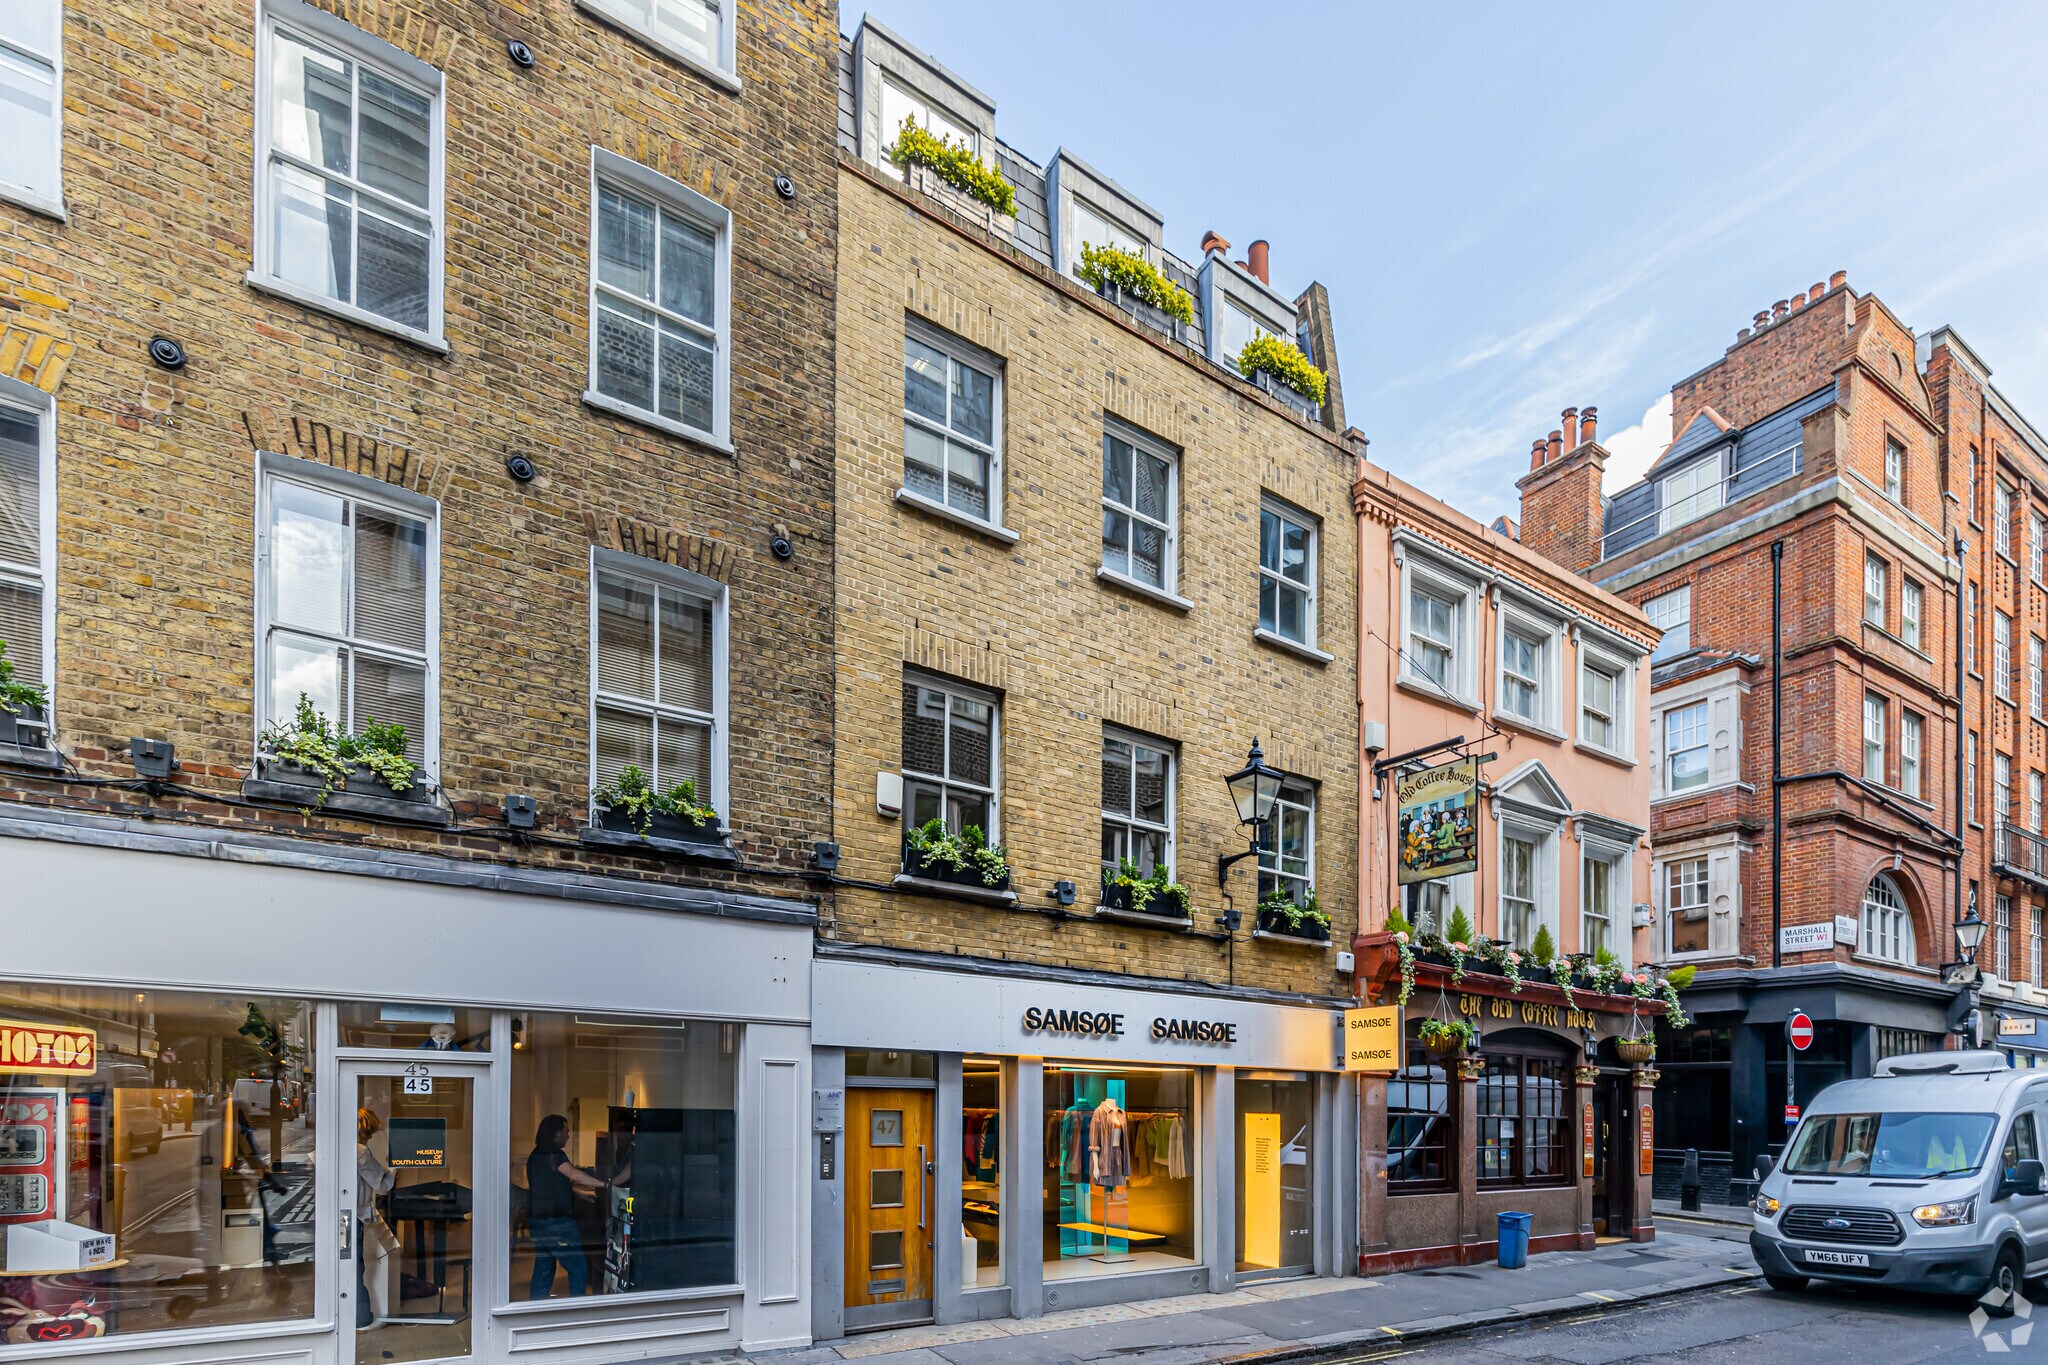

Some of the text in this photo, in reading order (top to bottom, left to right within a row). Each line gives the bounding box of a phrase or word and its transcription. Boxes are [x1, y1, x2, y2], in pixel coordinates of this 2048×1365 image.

[1399, 767, 1474, 804] Old Coffee House
[1785, 926, 1827, 936] MARSHALL
[1785, 935, 1814, 945] STREET
[1460, 993, 1598, 1032] THE OLD COFFEE HOUSE
[1025, 1006, 1237, 1043] SAMSØE SAMSØE
[1351, 1018, 1392, 1029] SAMSØE
[1351, 1050, 1392, 1061] SAMSØE
[404, 1062, 429, 1076] 45
[406, 1078, 430, 1092] 45
[876, 1119, 897, 1134] 47
[95, 1237, 112, 1246] WAVE
[1810, 1252, 1863, 1264] YM66 UFY
